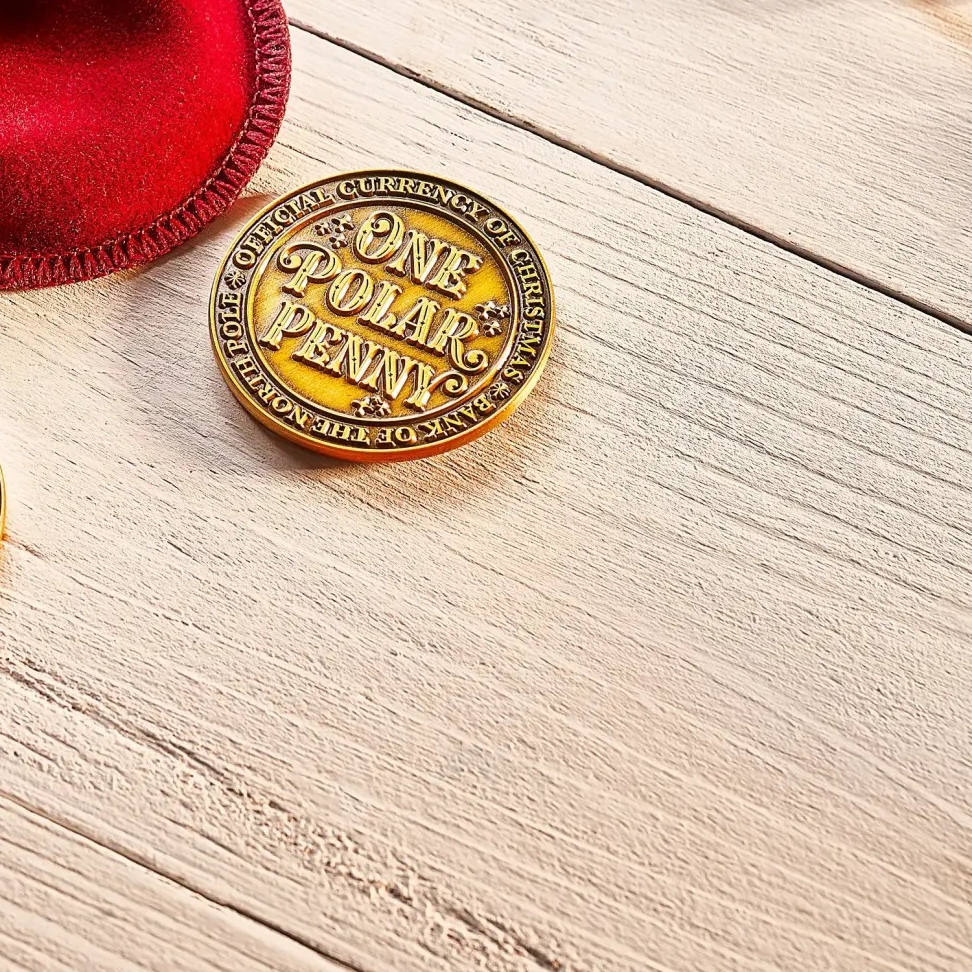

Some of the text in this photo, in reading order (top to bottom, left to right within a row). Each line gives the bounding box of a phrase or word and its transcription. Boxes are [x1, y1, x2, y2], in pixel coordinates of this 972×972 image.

[234, 176, 545, 382] OFFICIAL CURRENCY OF CHRISTMAS
[278, 241, 489, 376] POLAR
[354, 209, 484, 300] ONE
[219, 291, 496, 446] BANK OF THE NORTH POLE
[258, 299, 469, 412] PENNY
